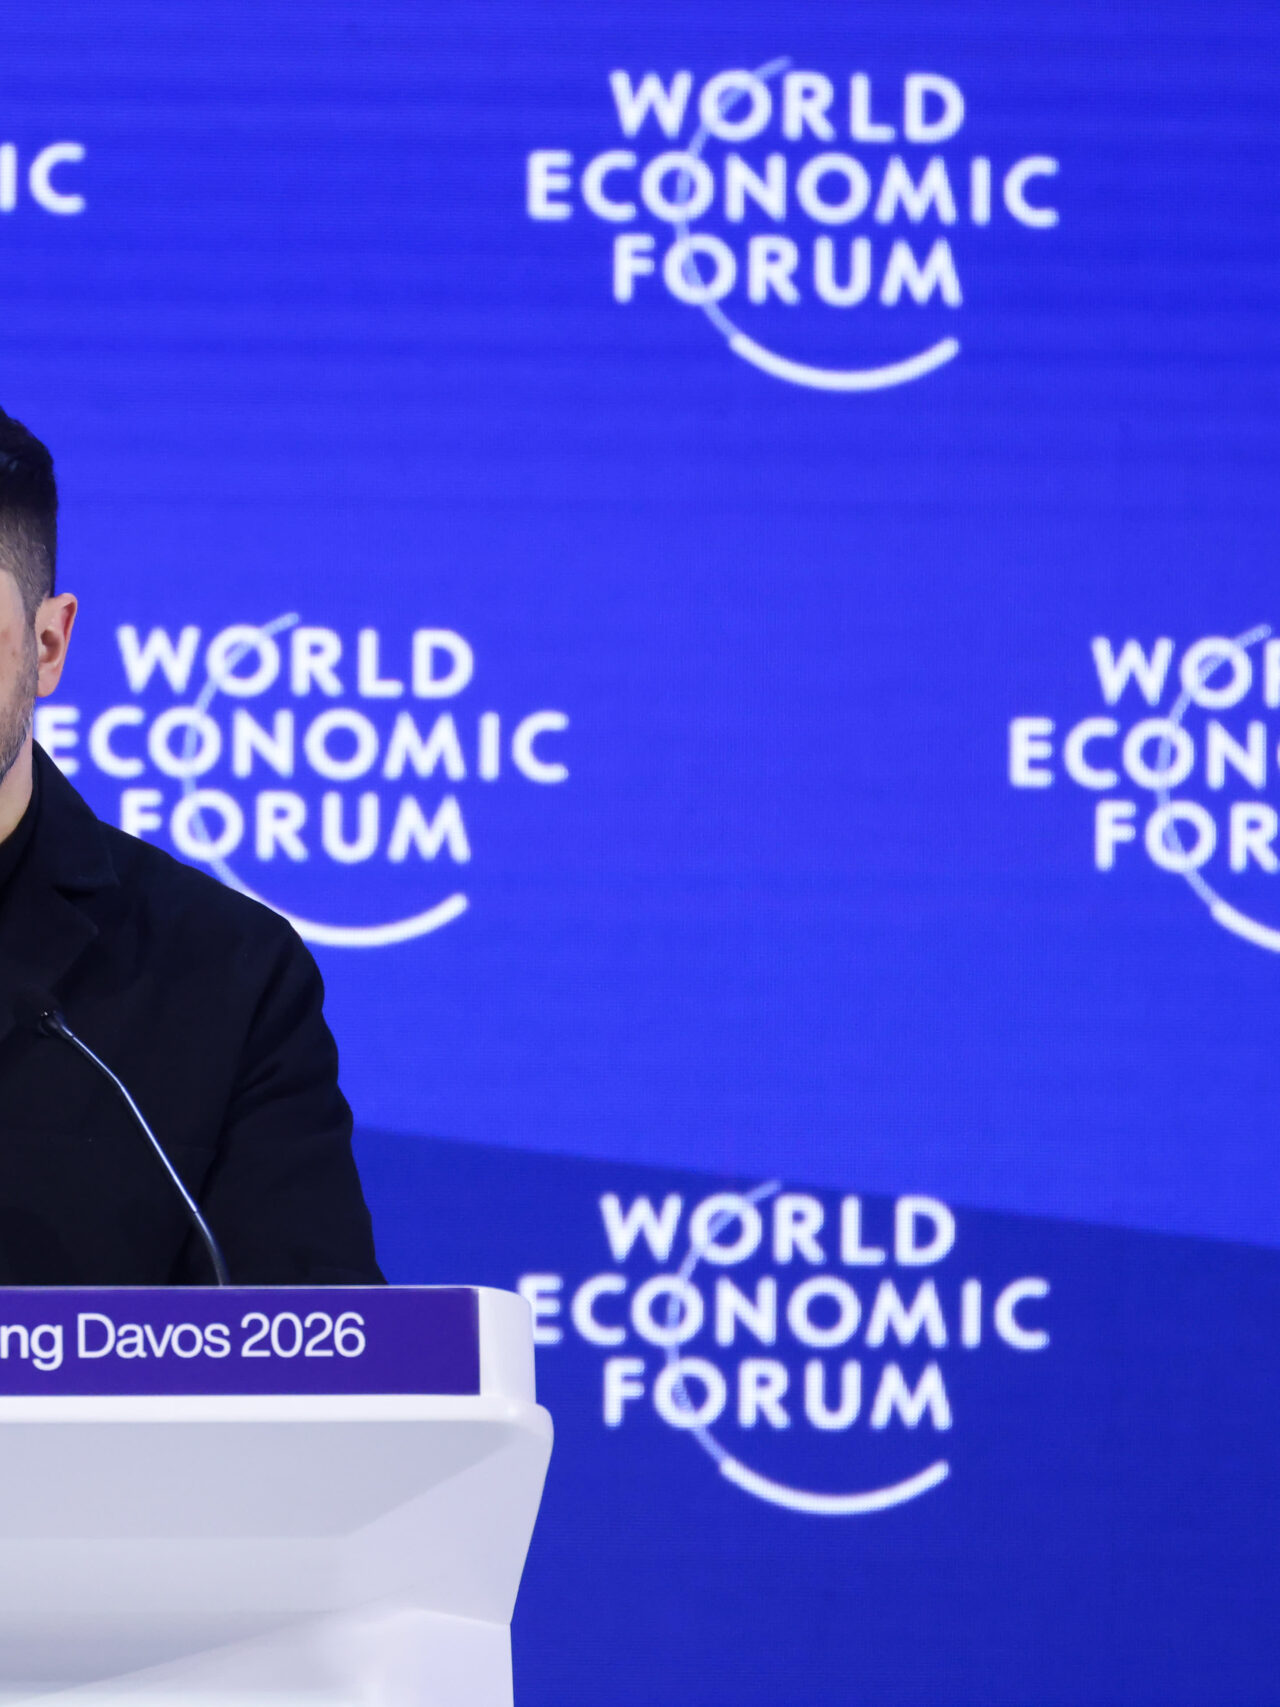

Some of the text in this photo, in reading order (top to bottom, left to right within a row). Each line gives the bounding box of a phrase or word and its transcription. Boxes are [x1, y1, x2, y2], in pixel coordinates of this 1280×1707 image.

[609, 69, 966, 143] WORLD
[527, 149, 1058, 228] ECONOMIC
[613, 233, 962, 307] FORUM
[116, 624, 474, 699] WORLD
[35, 704, 570, 784] ECONOMIC
[1009, 716, 1280, 791] ECON
[120, 787, 472, 864] FORUM
[1094, 799, 1280, 874] FOR
[600, 1193, 956, 1266] WORLD
[77, 1312, 231, 1359] Davos
[240, 1311, 366, 1358] 2026
[517, 1273, 1049, 1350] ECONOMIC
[603, 1357, 952, 1430] FORUM
